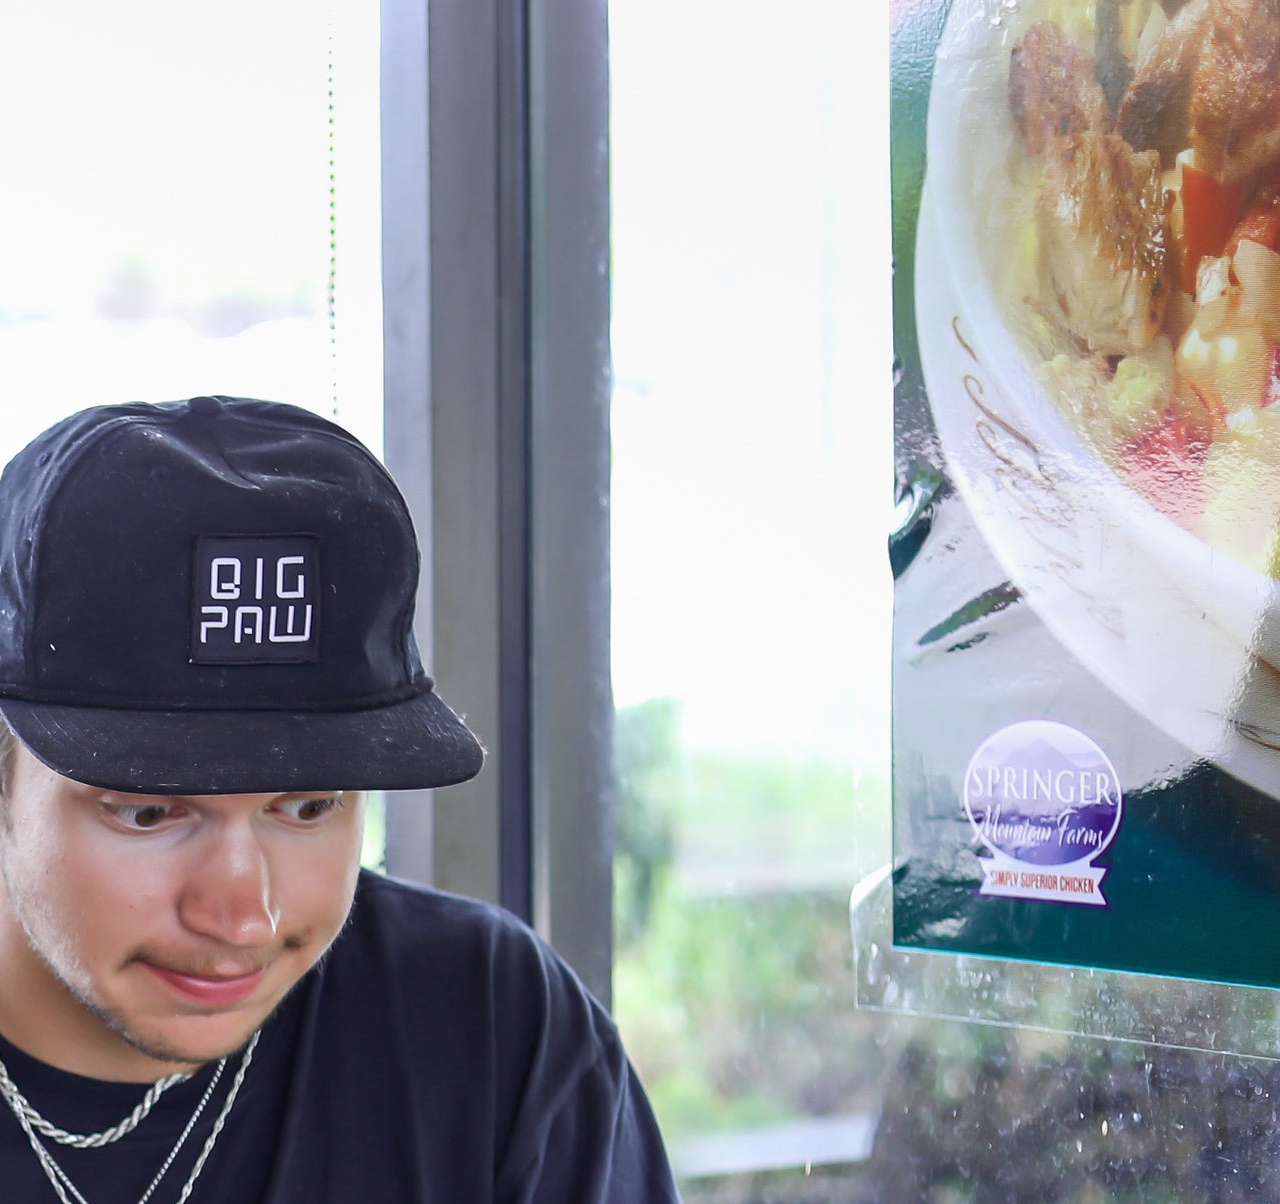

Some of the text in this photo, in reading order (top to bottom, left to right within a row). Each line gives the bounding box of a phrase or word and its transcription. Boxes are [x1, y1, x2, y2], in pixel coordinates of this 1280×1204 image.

[211, 556, 304, 600] BIG
[201, 604, 312, 643] PAW
[971, 766, 1115, 806] SPRINGER
[971, 803, 1103, 848] Mountain Farms
[990, 870, 1094, 894] SIMPLY SUPERIOR CHICKEN
